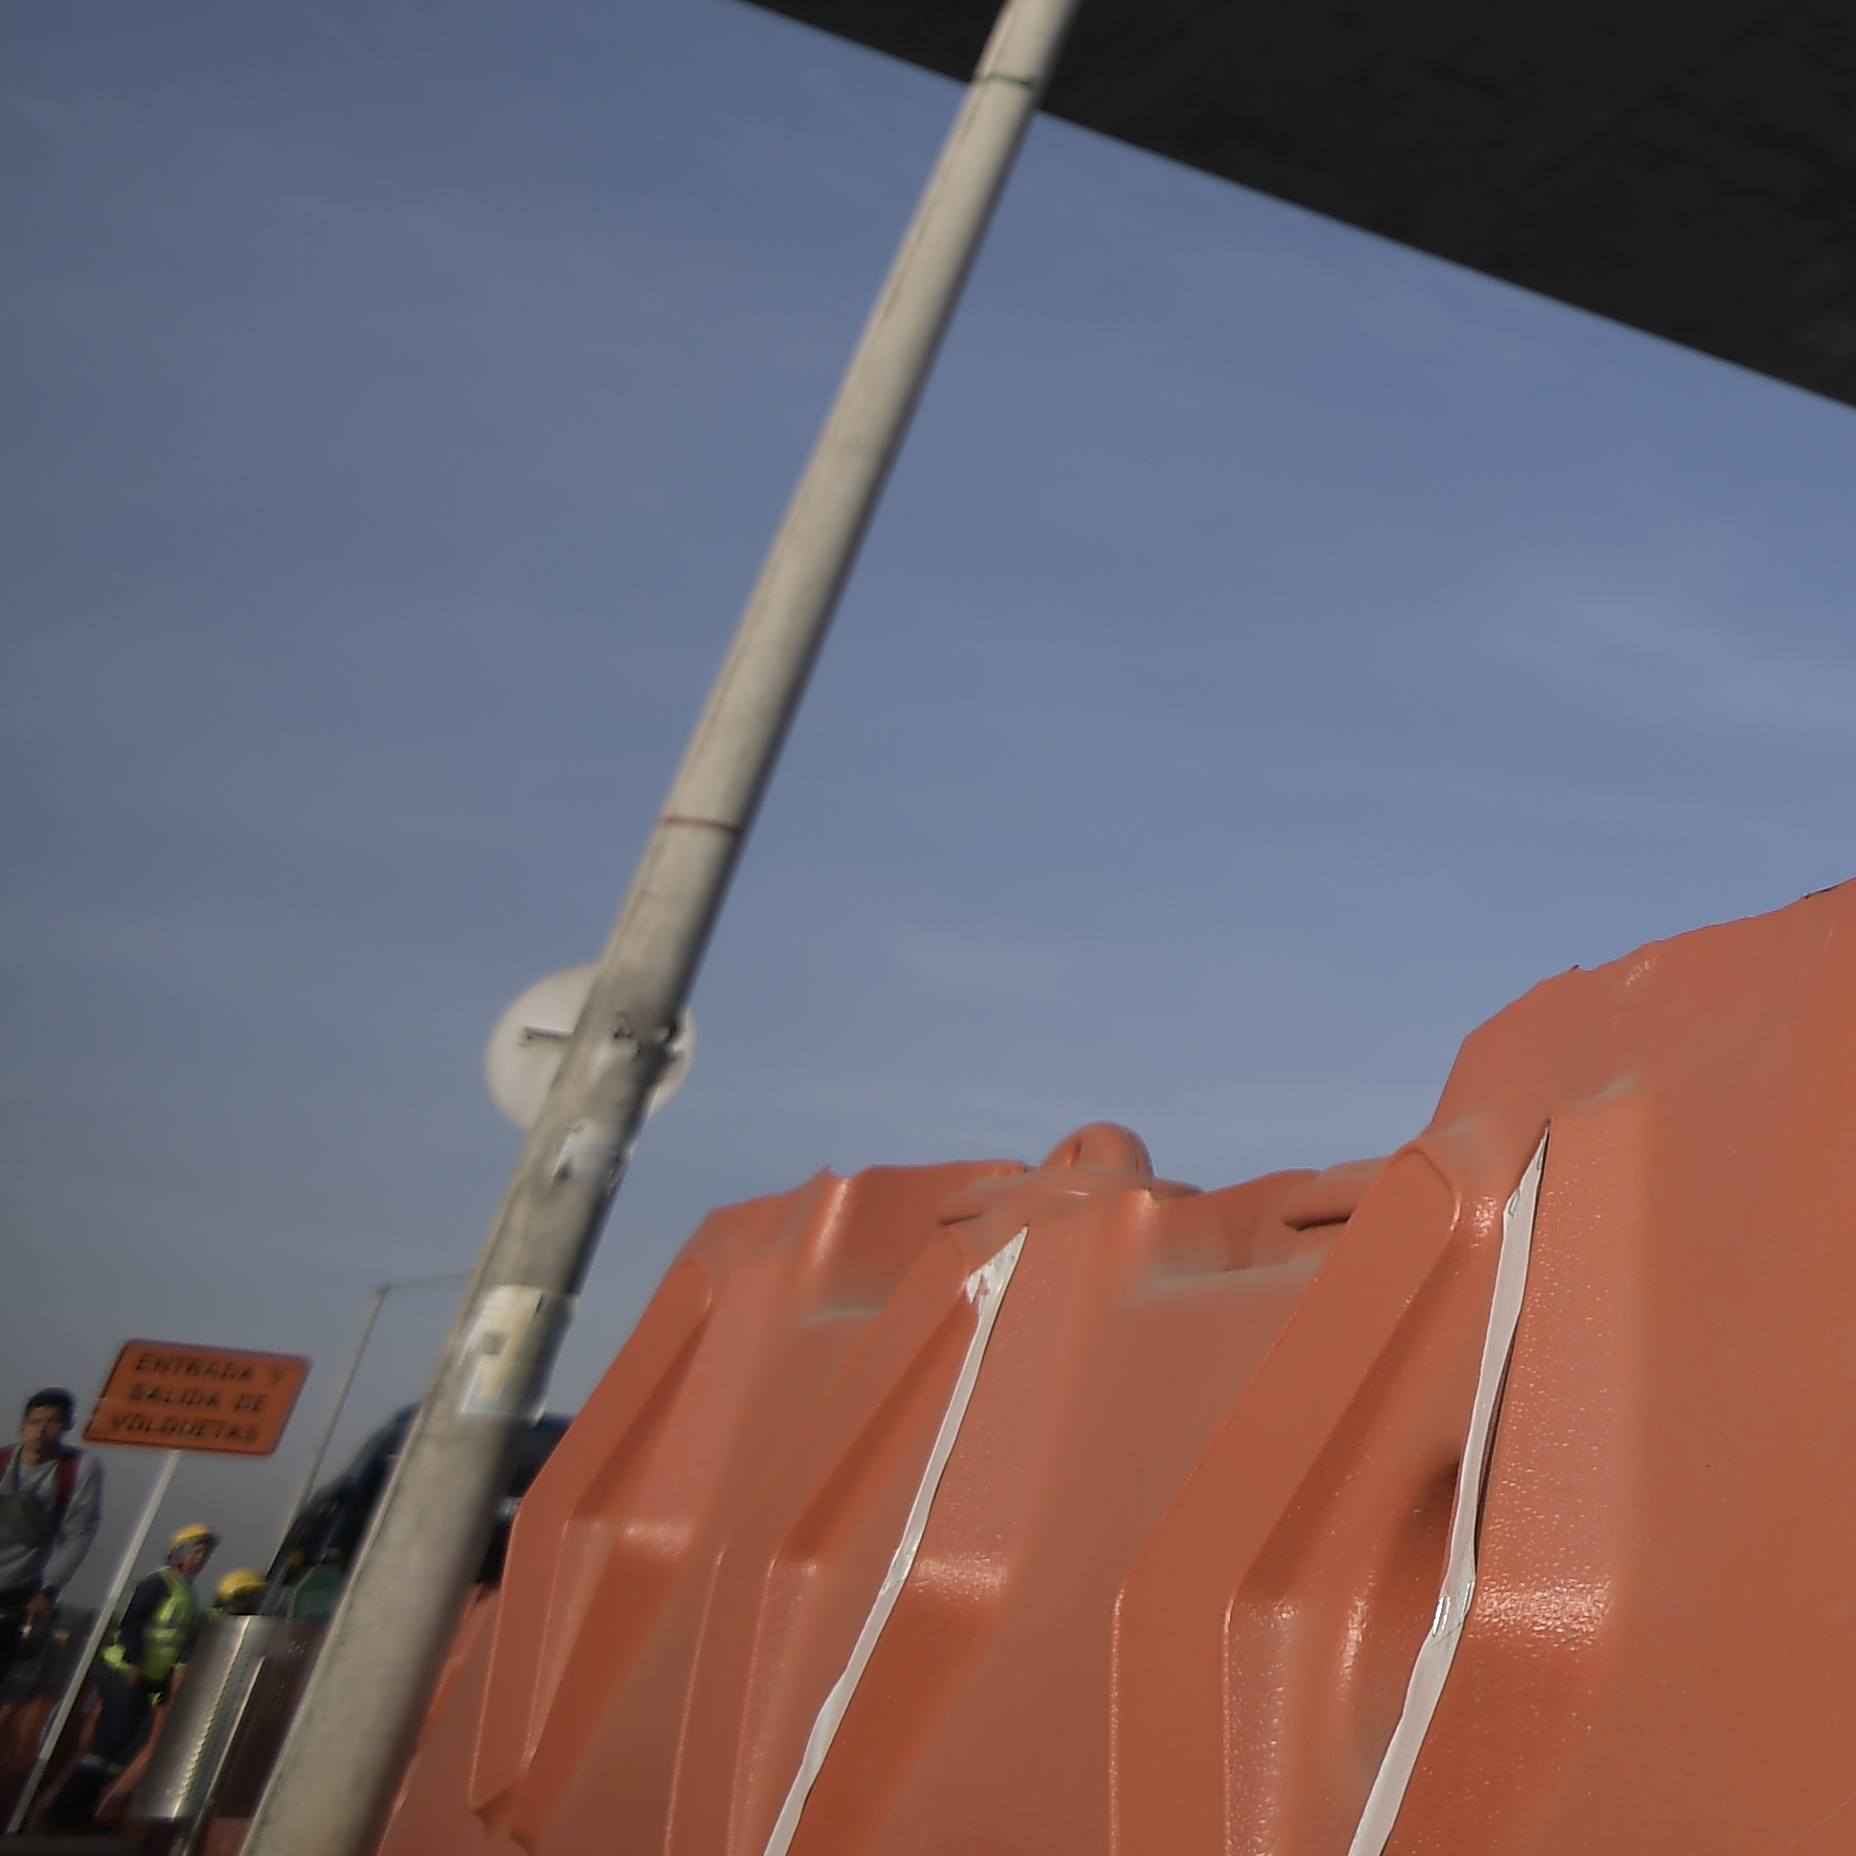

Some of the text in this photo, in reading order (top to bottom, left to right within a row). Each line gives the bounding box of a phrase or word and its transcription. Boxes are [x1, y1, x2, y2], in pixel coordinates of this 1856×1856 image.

[135, 1353, 287, 1384] ENTRADA Y
[130, 1383, 266, 1412] SALIDA DE
[111, 1412, 259, 1442] VOLQUETAS
